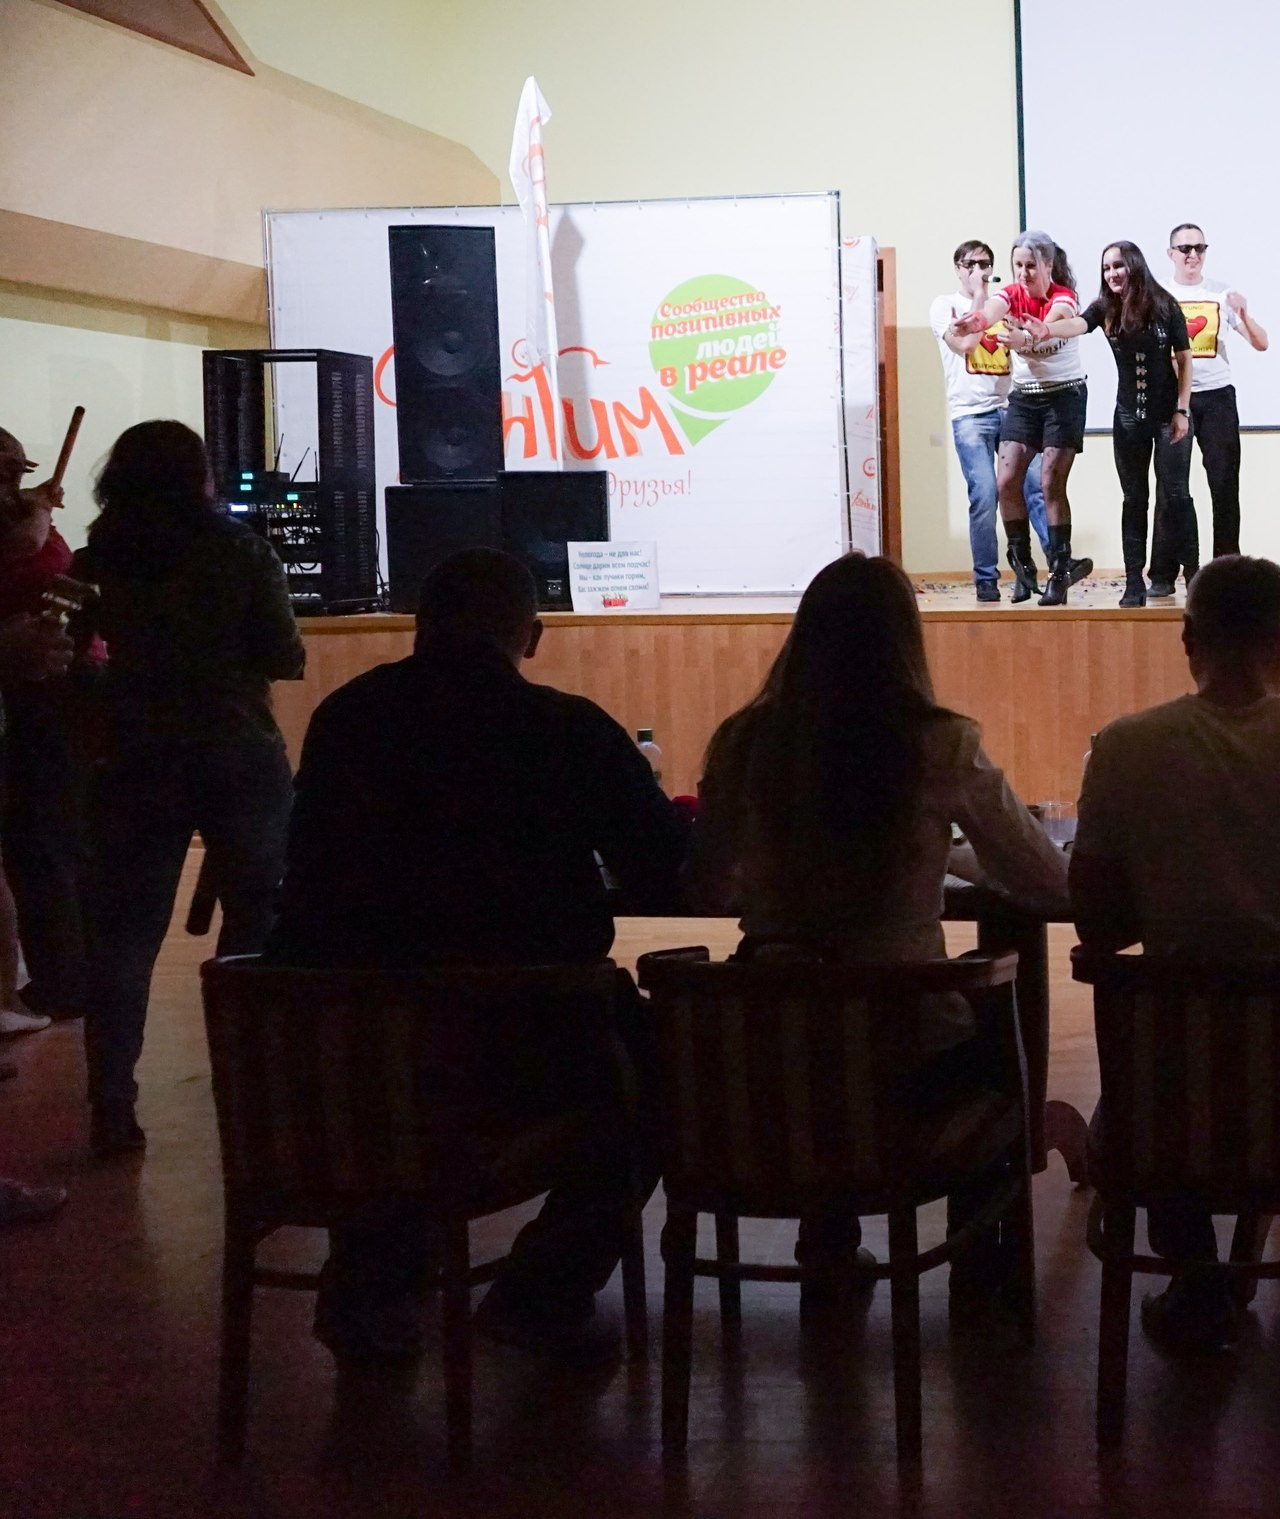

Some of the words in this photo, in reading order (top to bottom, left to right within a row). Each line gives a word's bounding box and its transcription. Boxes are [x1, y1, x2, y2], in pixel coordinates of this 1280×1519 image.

[651, 305, 782, 339] позитивных
[660, 291, 766, 318] Сообщество
[696, 321, 780, 360] людей
[660, 366, 678, 388] в
[687, 348, 787, 391] реале
